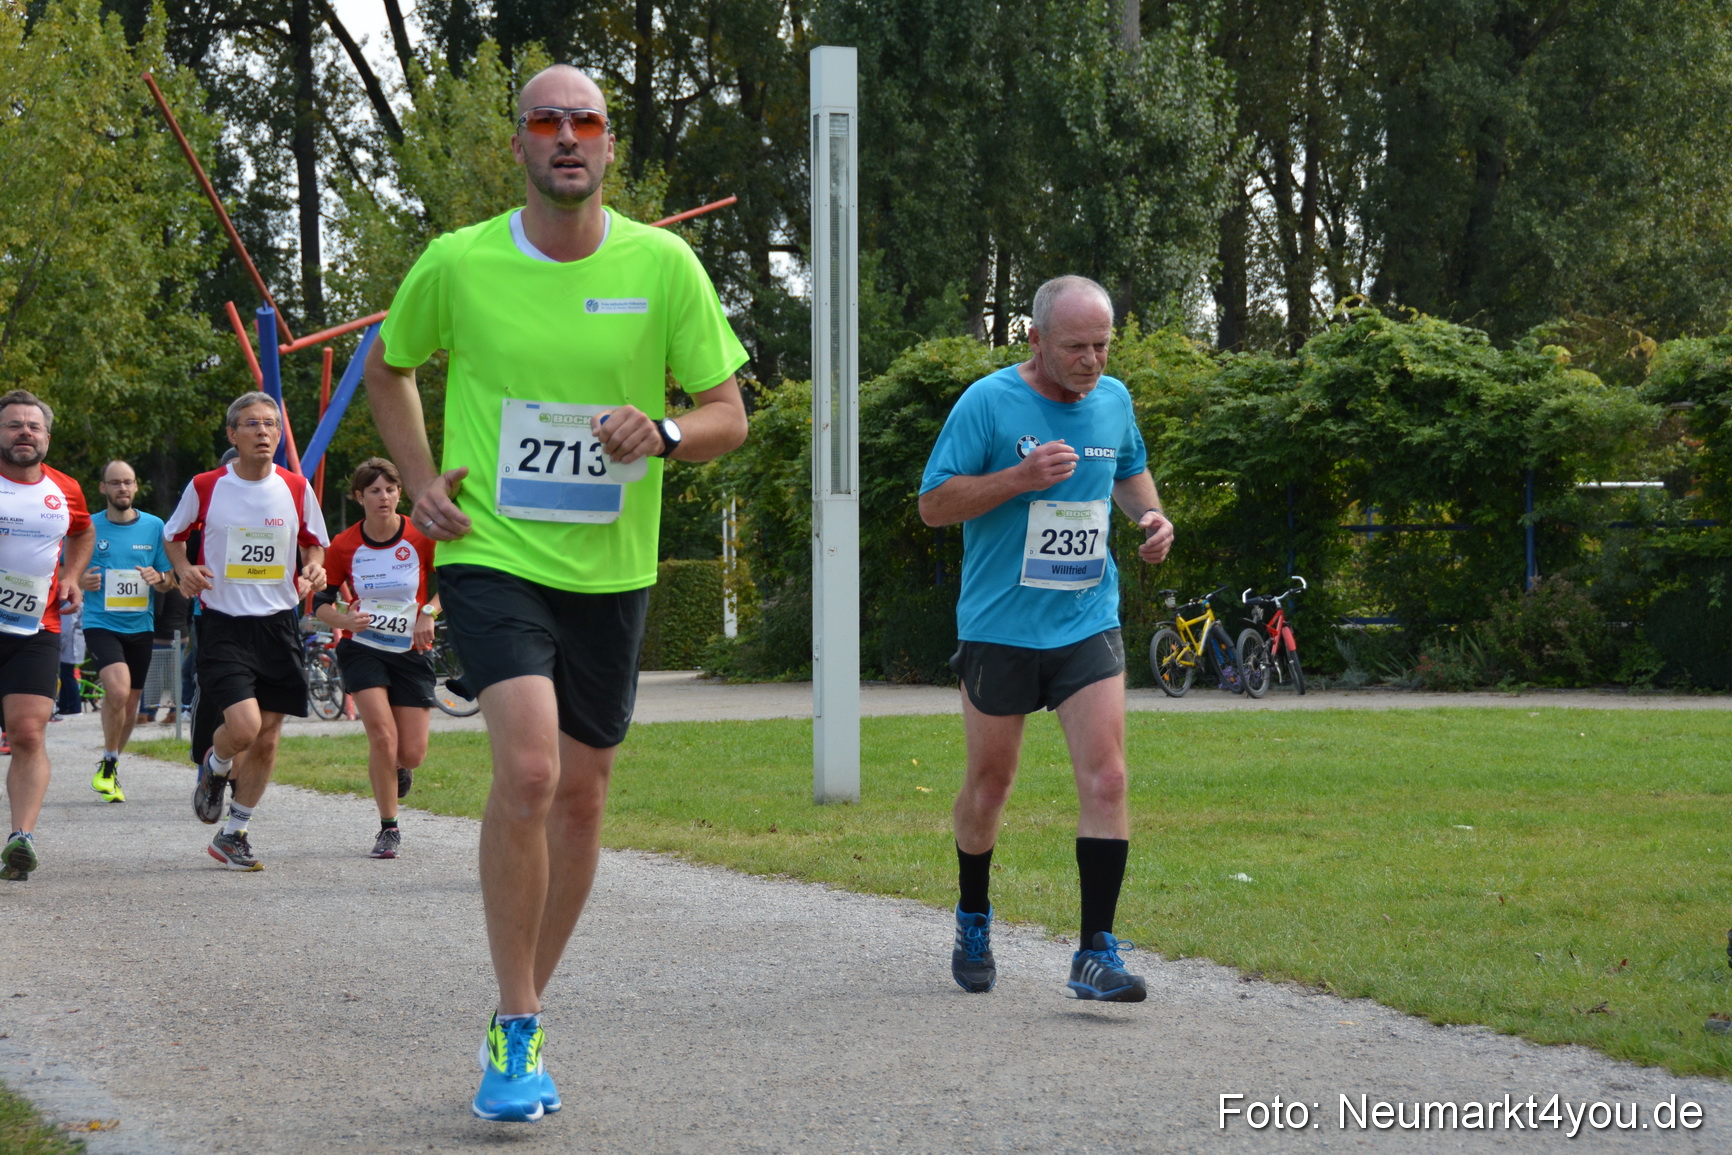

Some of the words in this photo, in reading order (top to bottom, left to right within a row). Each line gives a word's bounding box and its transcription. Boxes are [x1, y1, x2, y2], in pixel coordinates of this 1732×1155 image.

[552, 414, 591, 426] BOCK
[518, 437, 607, 477] 2713
[1084, 447, 1115, 458] BOCK
[41, 513, 65, 521] KOPPE
[265, 518, 284, 526] MID
[1039, 529, 1099, 556] 2337
[241, 544, 275, 562] 259
[247, 567, 266, 575] Albert
[392, 562, 413, 570] KOPPE
[1051, 564, 1087, 575] Willfried
[117, 582, 139, 595] 301
[368, 614, 408, 634] 2243
[372, 633, 396, 643] Stefanie
